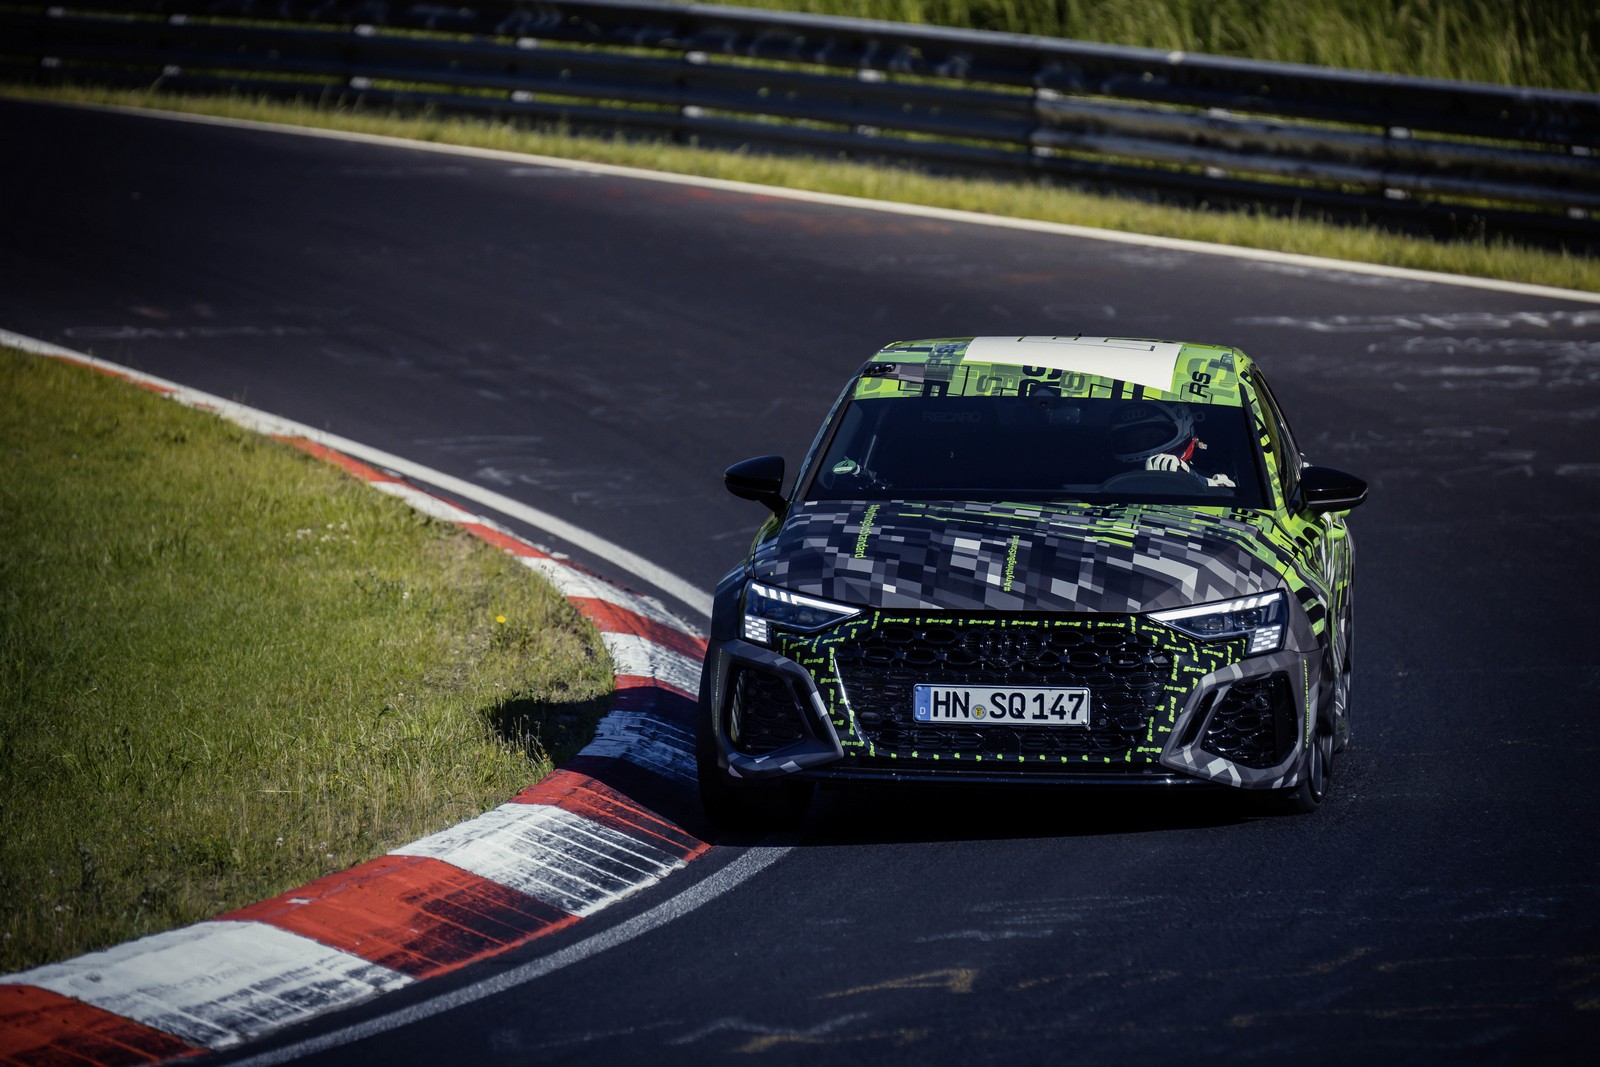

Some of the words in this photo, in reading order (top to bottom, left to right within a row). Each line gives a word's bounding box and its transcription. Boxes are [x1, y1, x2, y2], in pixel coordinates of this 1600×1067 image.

[1188, 371, 1211, 398] RS
[919, 706, 926, 715] D
[933, 690, 970, 718] HN
[989, 692, 1026, 720] SQ
[1032, 693, 1085, 720] 147
